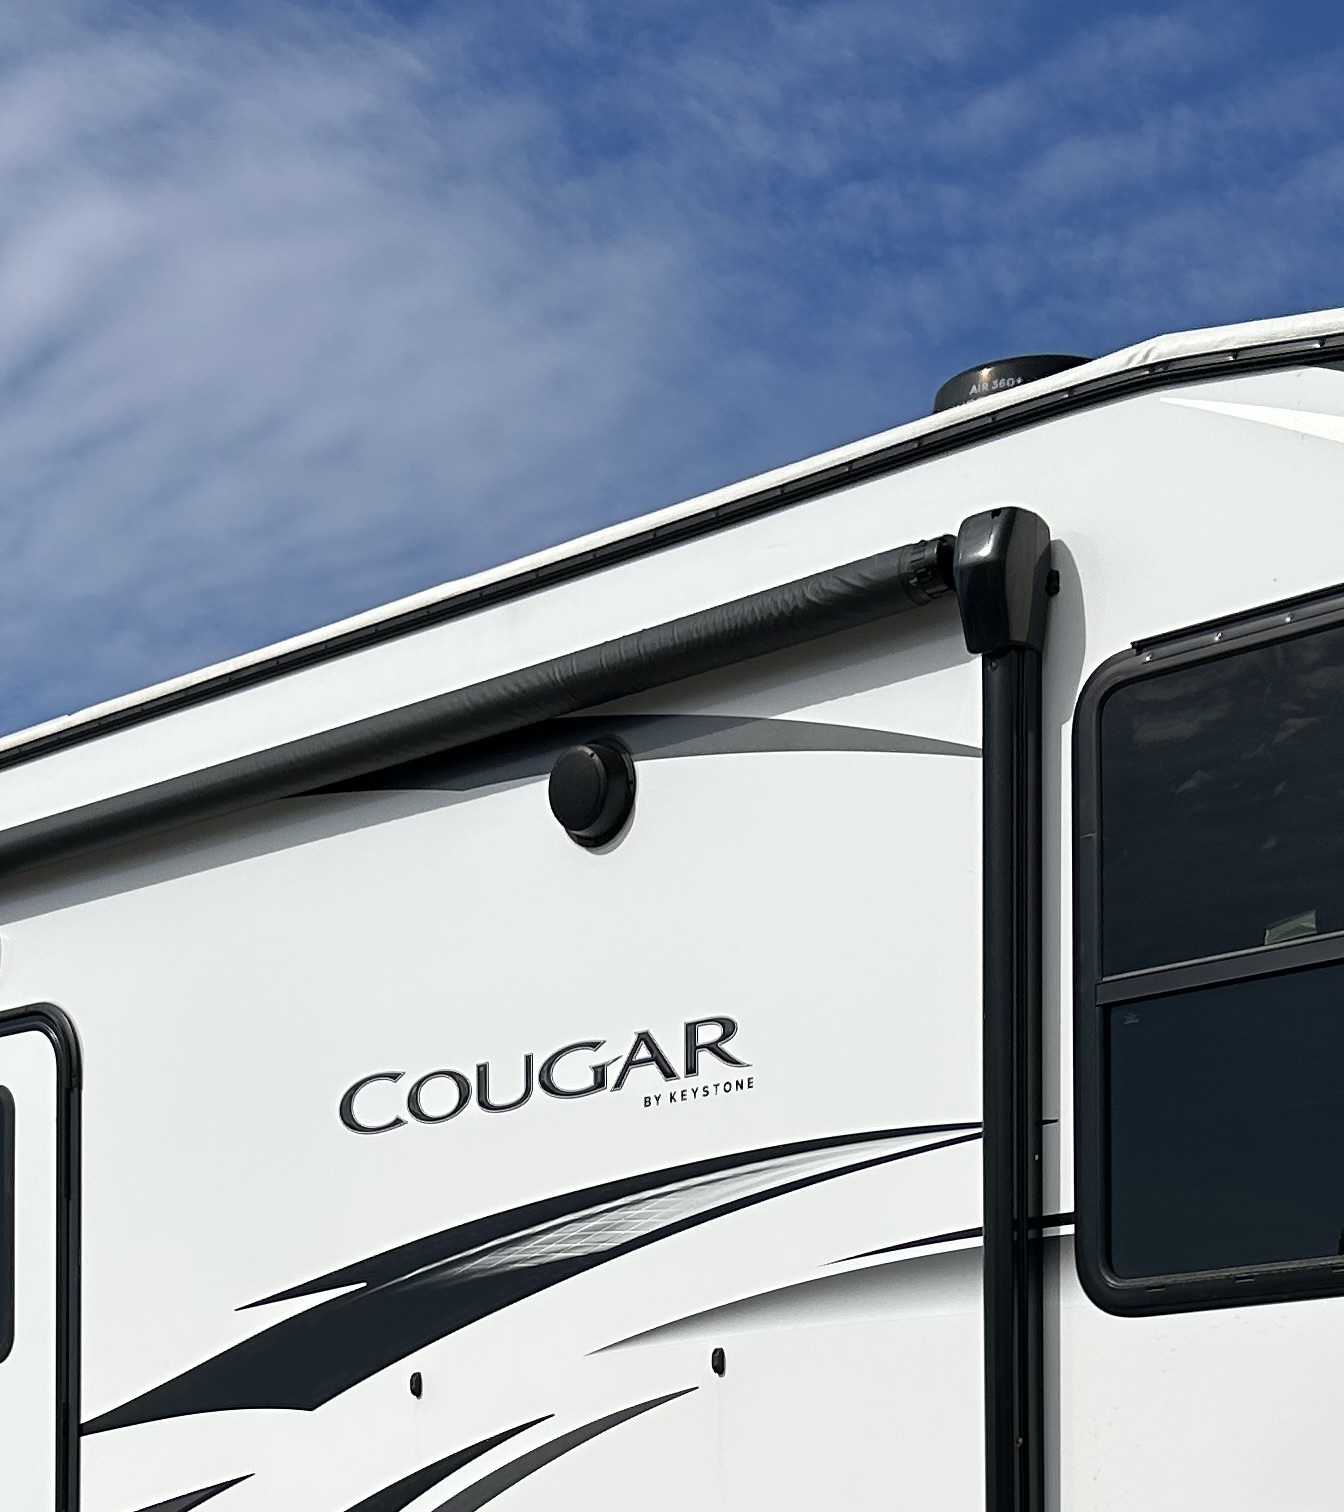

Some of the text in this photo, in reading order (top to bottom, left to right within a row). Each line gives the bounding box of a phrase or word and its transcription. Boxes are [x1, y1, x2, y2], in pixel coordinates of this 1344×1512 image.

[969, 383, 989, 396] AIR
[339, 1014, 753, 1135] COUGAR
[643, 1076, 756, 1108] BY KEYSTONE
